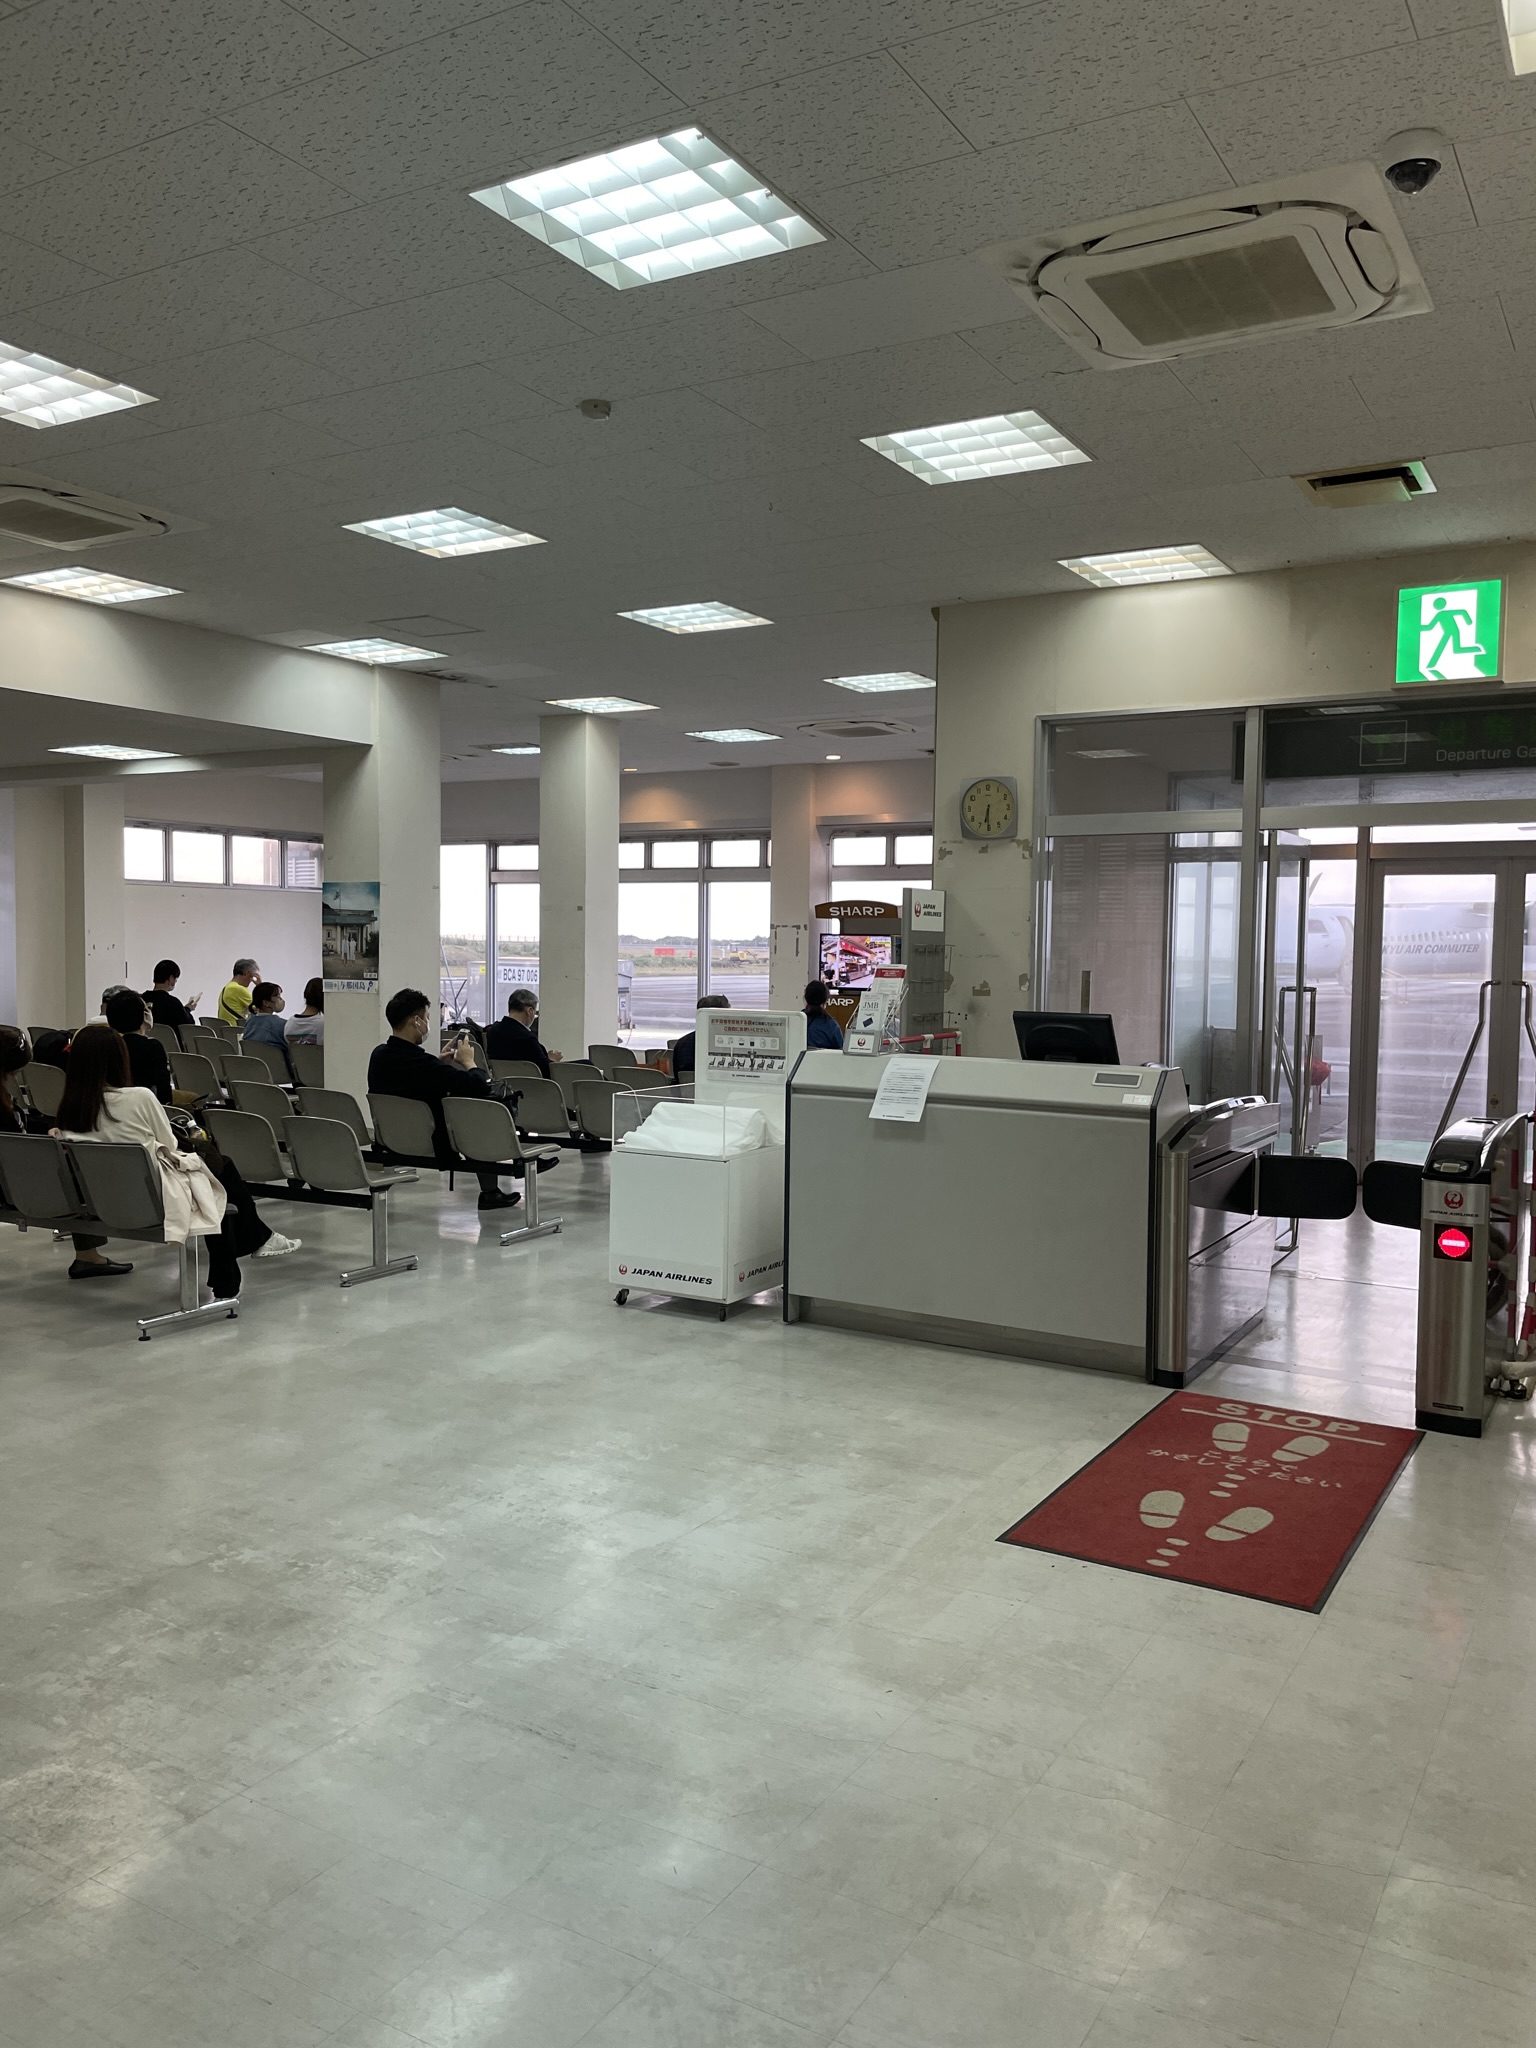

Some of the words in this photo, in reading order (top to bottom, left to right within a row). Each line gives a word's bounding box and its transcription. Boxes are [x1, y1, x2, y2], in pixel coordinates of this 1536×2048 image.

[1436, 747, 1512, 763] Departure
[1516, 744, 1536, 759] Ga
[829, 906, 885, 917] SHARP
[1382, 944, 1404, 956] KYU
[1405, 944, 1422, 955] AIR
[1424, 943, 1481, 955] COMMUTER
[503, 968, 517, 981] BCA
[825, 998, 854, 1007] HARP
[631, 1268, 663, 1279] JAPAN
[664, 1271, 713, 1286] AIRLINES
[747, 1265, 767, 1279] JAPAN
[767, 1260, 784, 1272] AIRLI
[1216, 1403, 1361, 1433] STOP
[1147, 1449, 1343, 1489] かざしてください
[1204, 1450, 1298, 1472] こちらで
